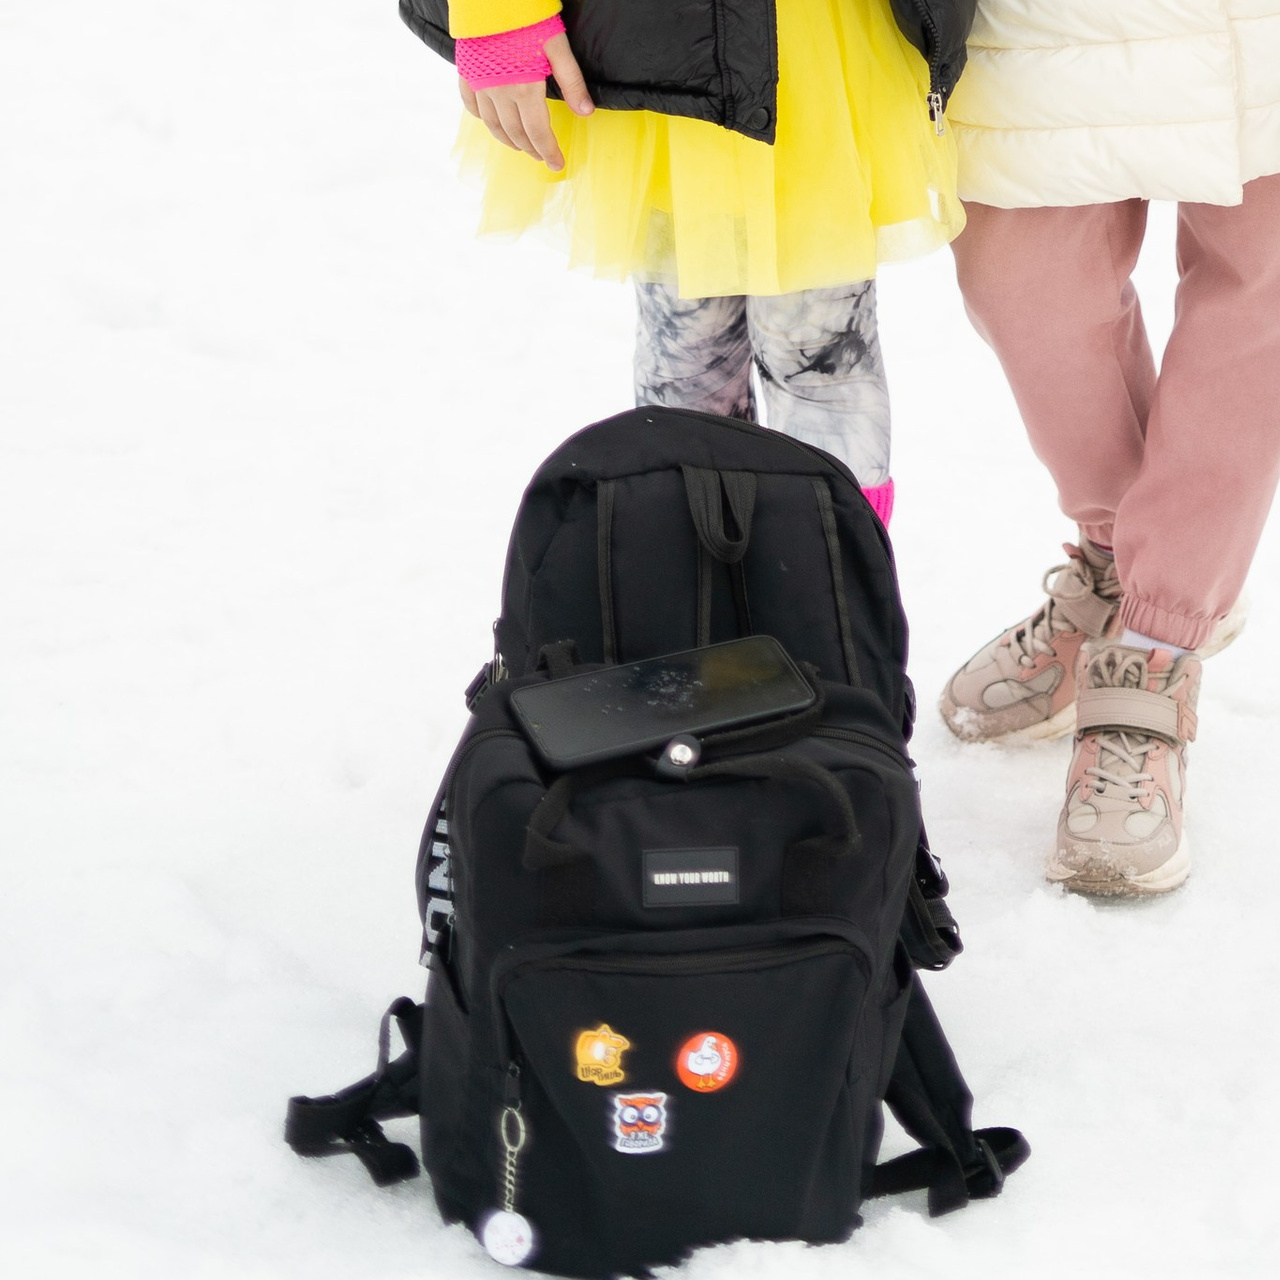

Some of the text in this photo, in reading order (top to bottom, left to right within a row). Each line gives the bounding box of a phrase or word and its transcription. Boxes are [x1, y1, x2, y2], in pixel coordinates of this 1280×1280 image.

[654, 871, 729, 885] KNOW YOUR WORTH
